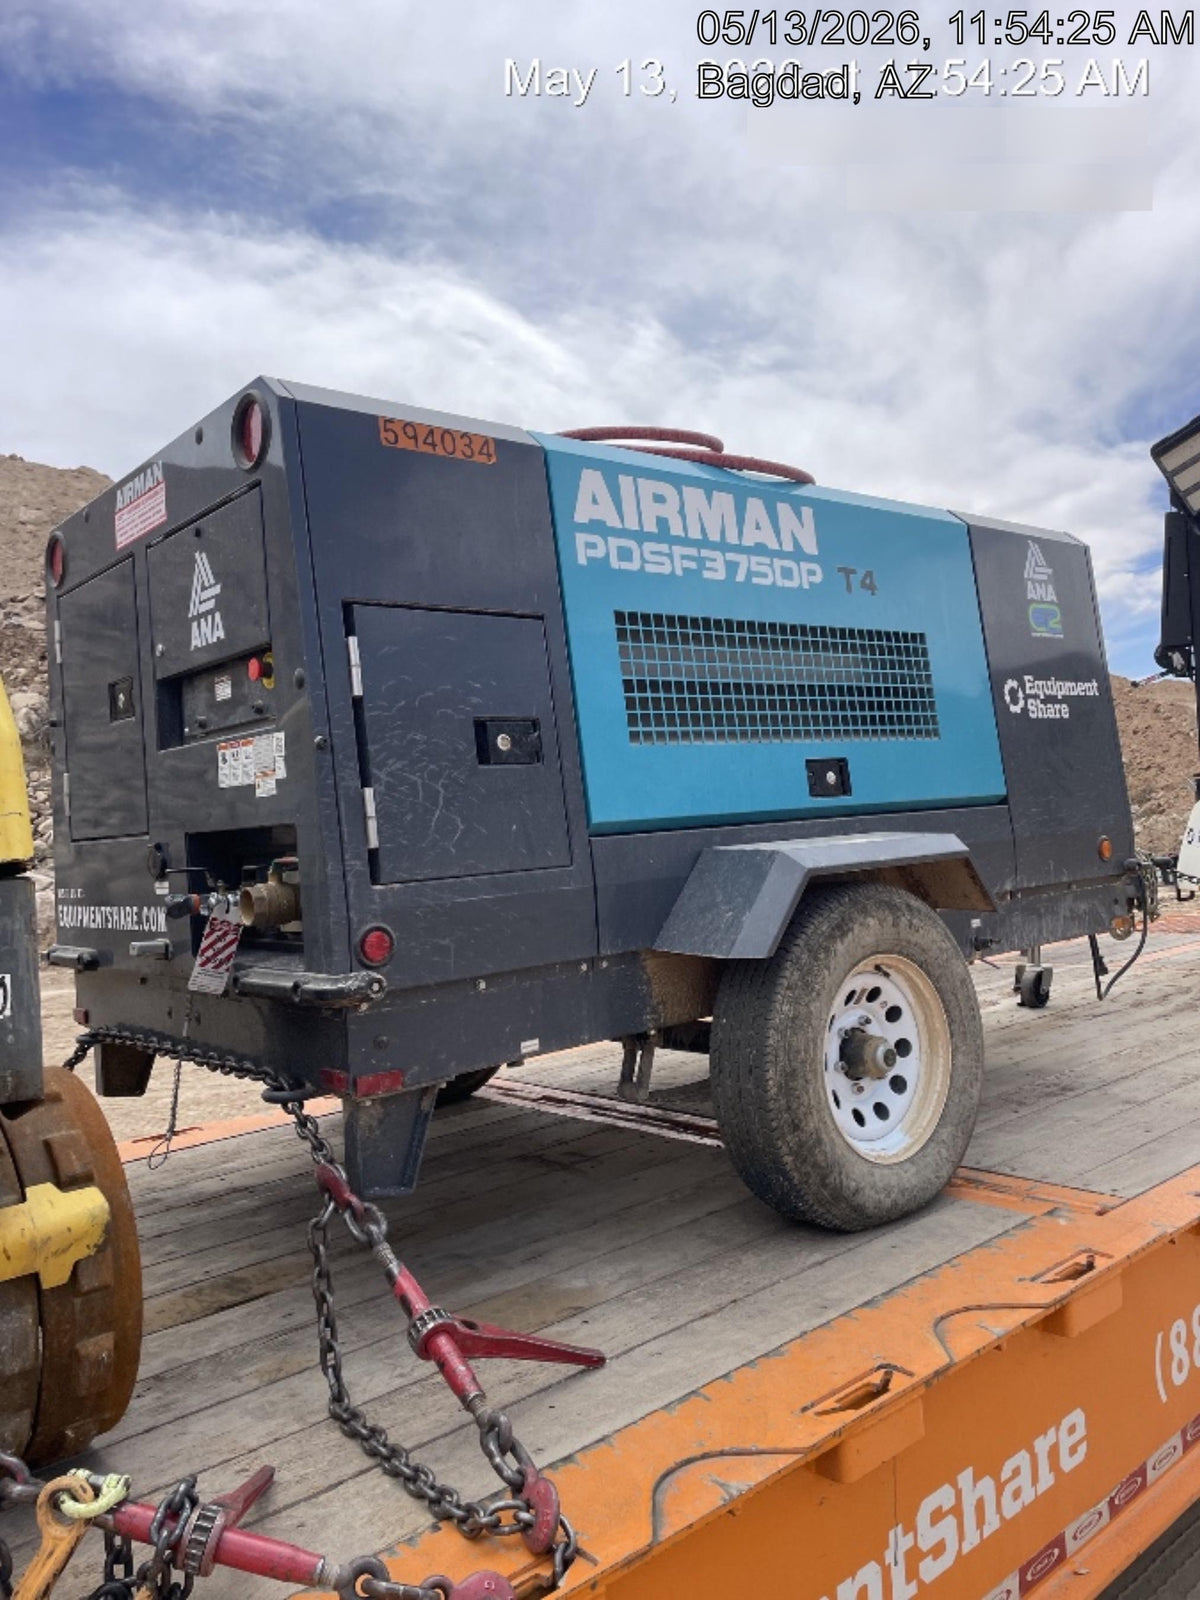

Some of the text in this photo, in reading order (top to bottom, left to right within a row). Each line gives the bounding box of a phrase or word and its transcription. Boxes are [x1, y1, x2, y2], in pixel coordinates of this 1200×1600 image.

[379, 417, 496, 463] 594034
[114, 460, 164, 514] AIRMAN
[573, 468, 819, 556] AIRMAN
[575, 532, 880, 597] PDSF375DP T4
[1026, 580, 1059, 604] ANA
[190, 611, 226, 651] ANA
[1023, 675, 1100, 700] Equipment
[1026, 698, 1070, 720] Share
[58, 904, 168, 932] EQUIPMENTSHARE.COM
[818, 1407, 1088, 1600] ntShare
